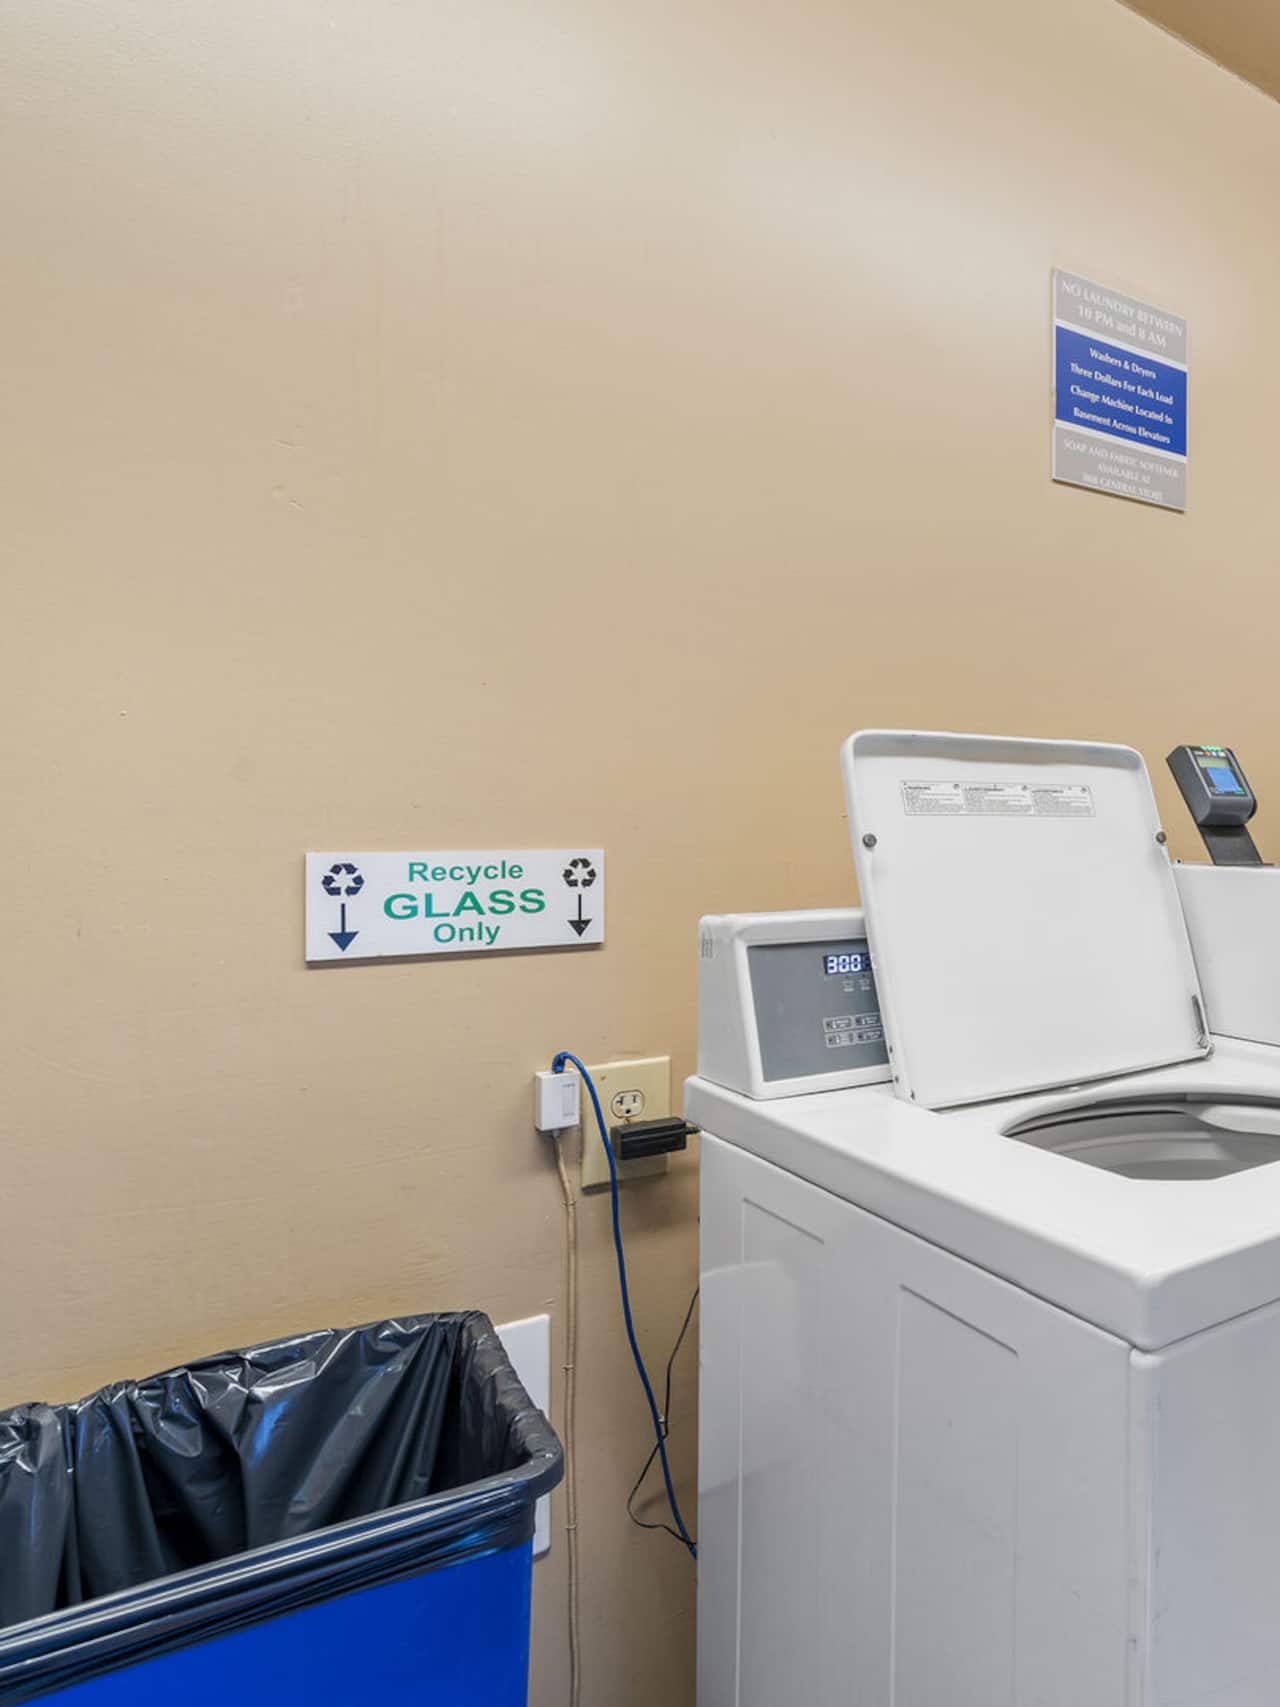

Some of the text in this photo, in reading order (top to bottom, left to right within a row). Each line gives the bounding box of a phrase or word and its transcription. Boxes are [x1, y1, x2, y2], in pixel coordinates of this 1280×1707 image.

[1062, 279, 1081, 297] NO
[1094, 309, 1114, 329] PM
[1148, 330, 1167, 348] AM
[1089, 347, 1158, 381] Washers & Dryers
[1070, 362, 1093, 379] Three
[1094, 370, 1122, 389] Dollars
[1137, 385, 1155, 400] Each
[1156, 391, 1173, 406] Load
[1070, 384, 1100, 404] Change
[1101, 393, 1135, 413] Machine
[1135, 405, 1165, 422] Located
[1073, 406, 1171, 444] Basement Across Elevators
[408, 859, 524, 885] Recycle
[383, 888, 546, 921] GLASS
[433, 922, 501, 946] Only
